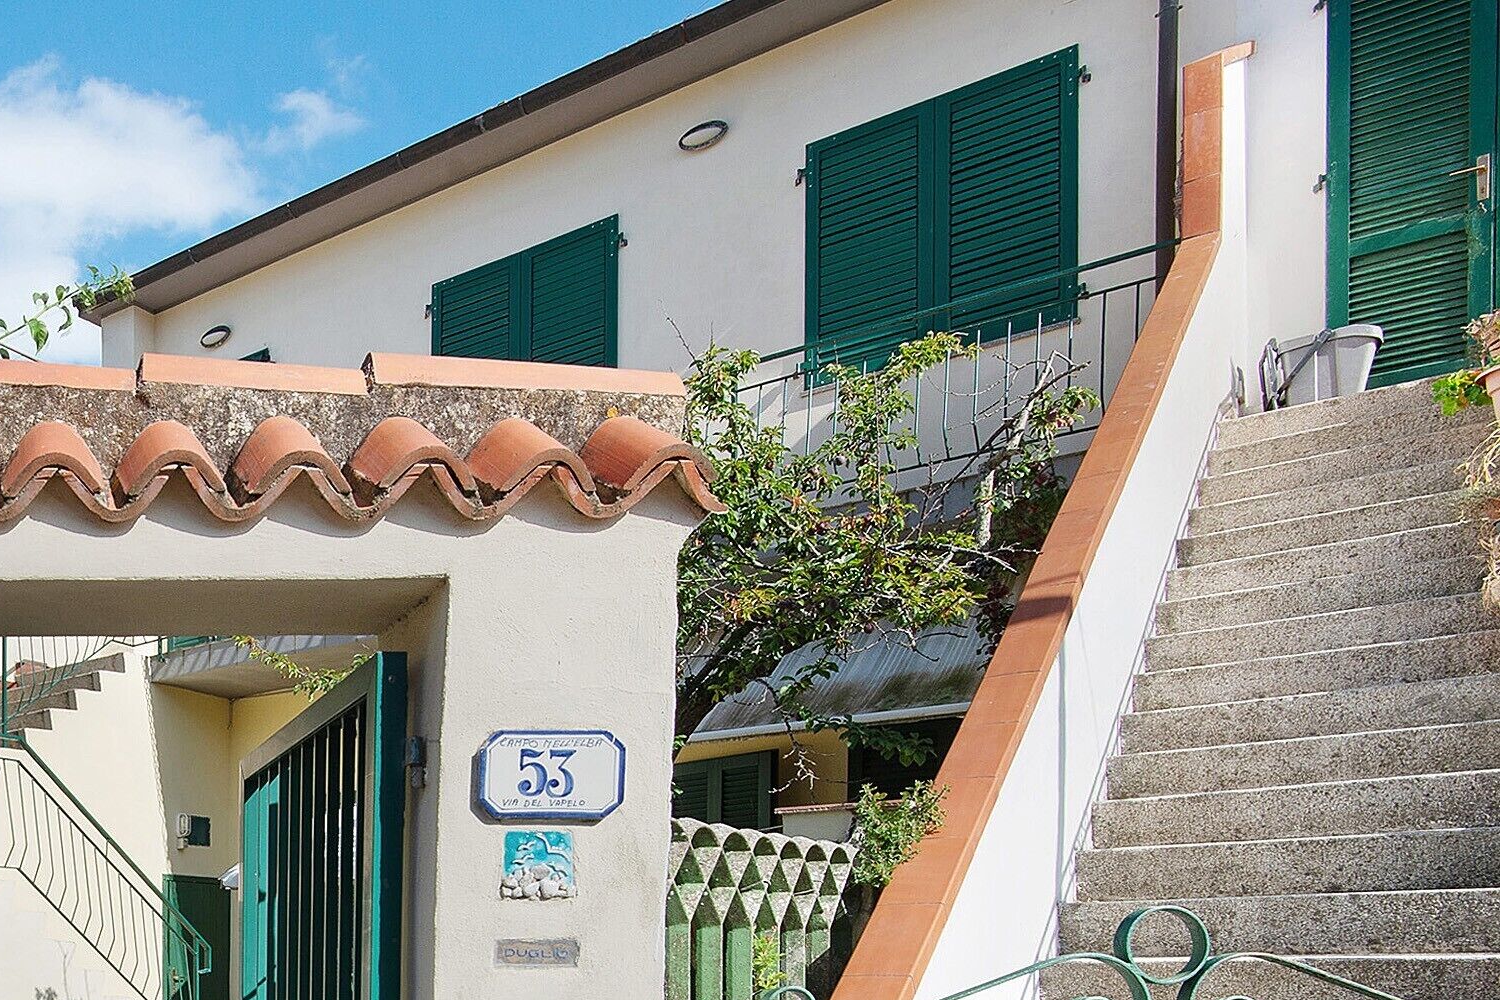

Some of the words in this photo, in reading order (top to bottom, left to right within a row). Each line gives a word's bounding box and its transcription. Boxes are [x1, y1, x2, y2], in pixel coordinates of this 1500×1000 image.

[500, 736, 538, 748] CAMPO
[517, 749, 577, 798] 53
[502, 798, 519, 807] VIA
[524, 799, 542, 808] DEL
[549, 799, 586, 808] VAPELO
